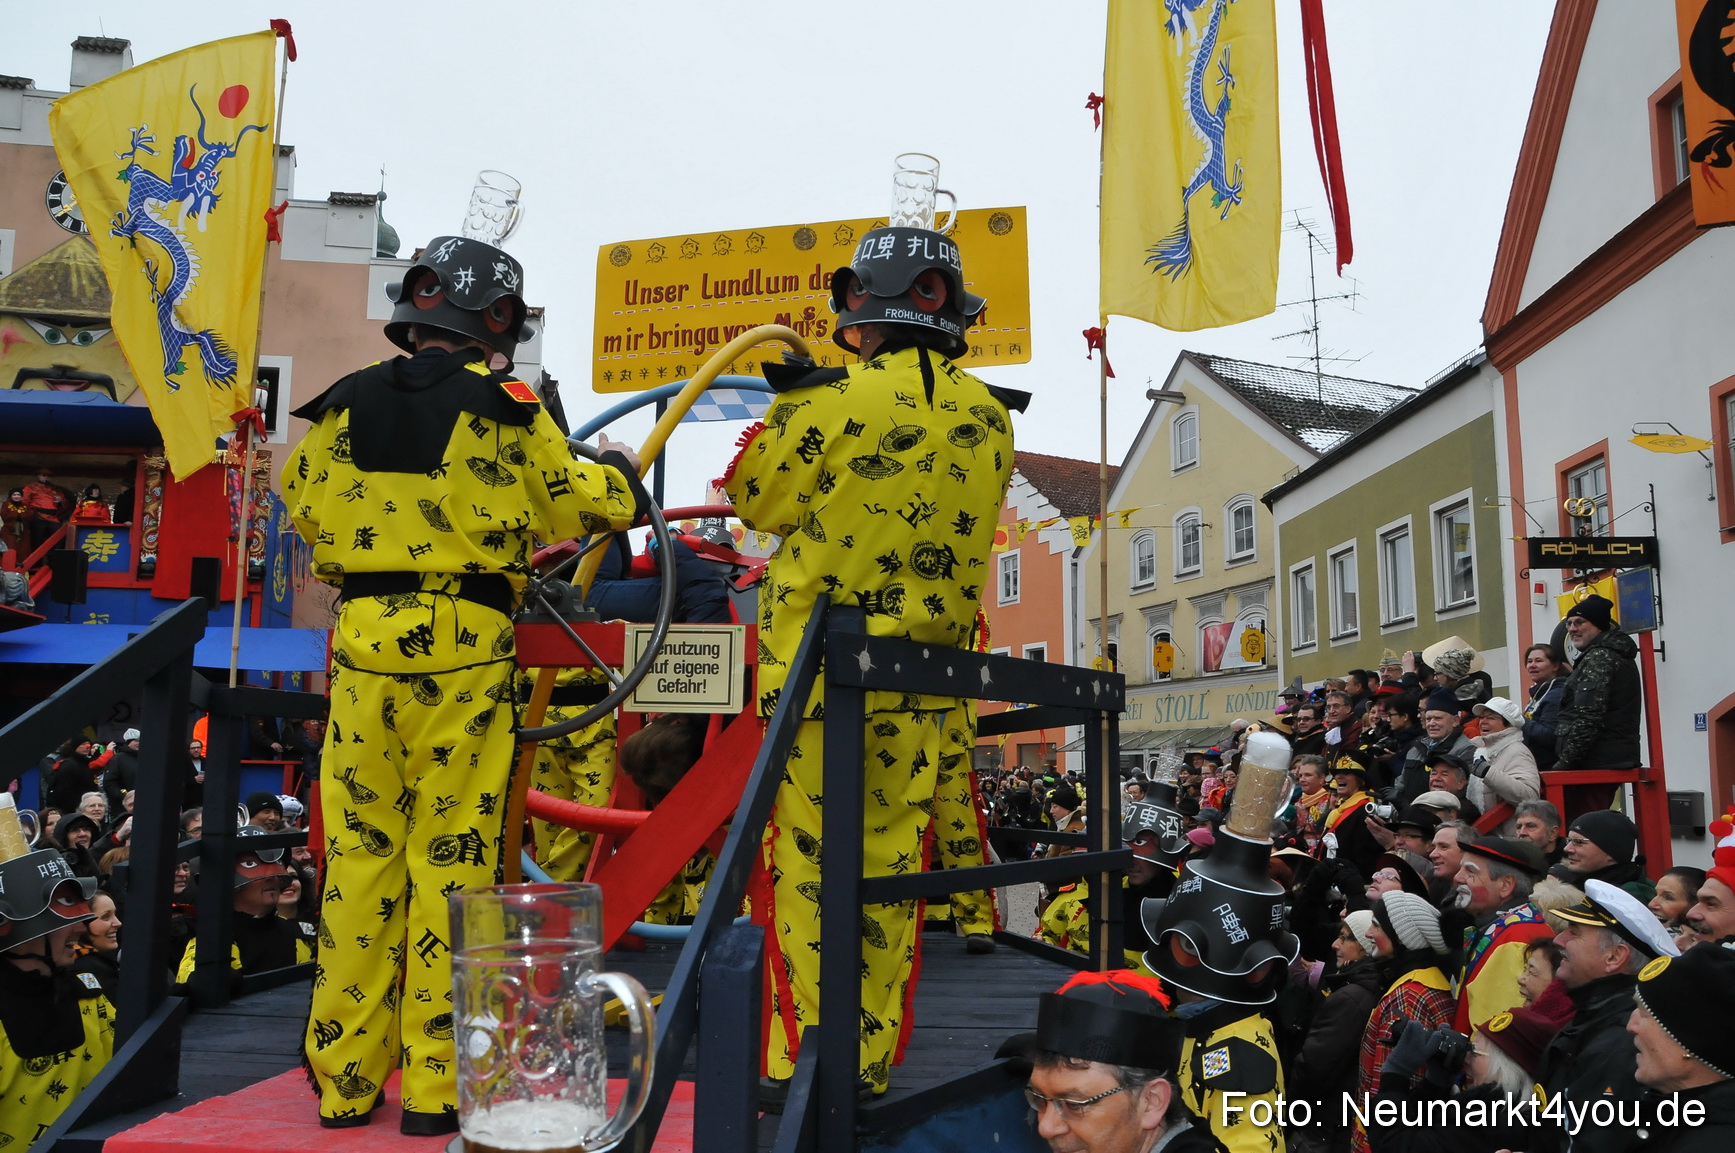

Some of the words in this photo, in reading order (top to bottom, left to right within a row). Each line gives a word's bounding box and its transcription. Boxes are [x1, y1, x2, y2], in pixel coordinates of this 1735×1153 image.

[624, 279, 689, 306] Unser
[701, 268, 800, 300] Lundlum
[885, 308, 935, 326] FRÖHLICHE
[939, 317, 961, 335] RUNDE
[602, 327, 645, 354] mir
[647, 322, 720, 357] bringa
[1541, 541, 1644, 556] RÖHLICH
[647, 640, 720, 660] enutzung
[673, 660, 720, 678] eigene
[657, 678, 707, 694] Gefahr!
[1154, 693, 1211, 724] STOLL
[1225, 690, 1279, 714] KONDIT
